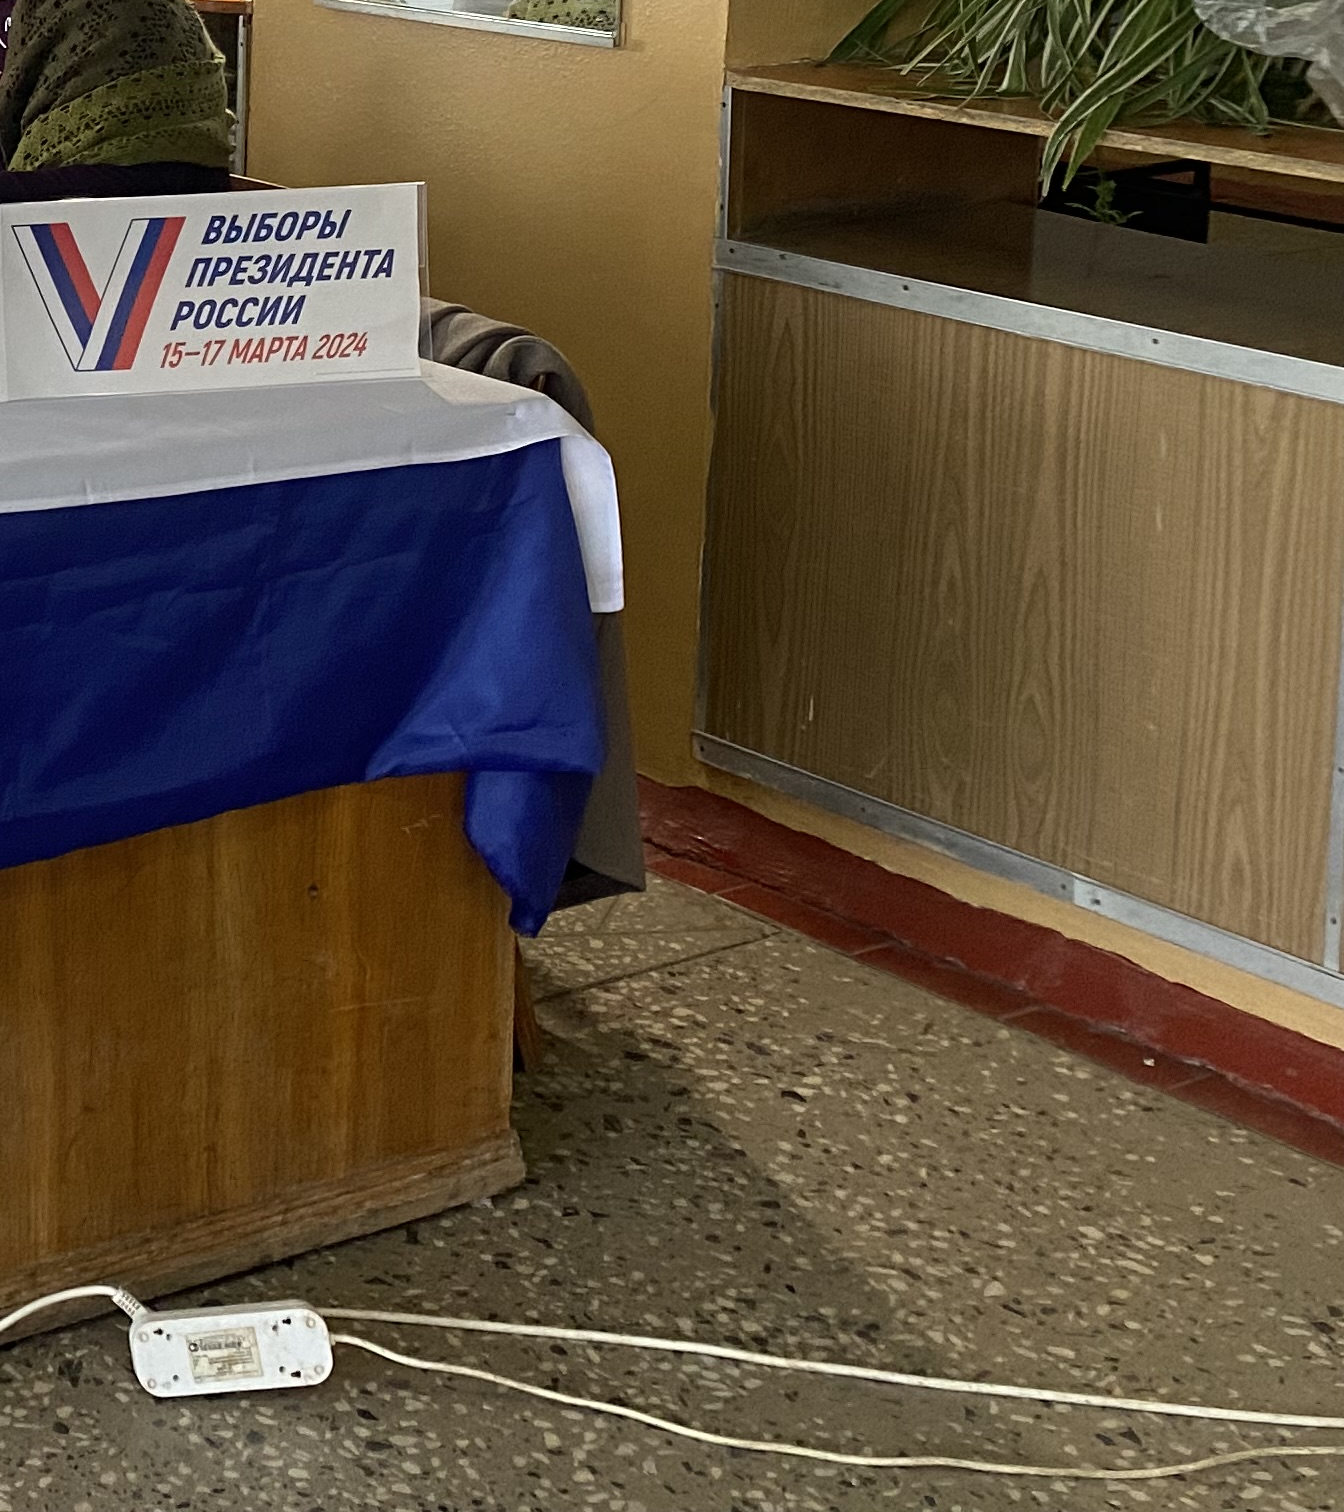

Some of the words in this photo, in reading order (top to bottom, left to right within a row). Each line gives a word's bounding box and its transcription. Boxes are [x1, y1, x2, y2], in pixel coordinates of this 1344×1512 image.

[201, 209, 352, 245] ВЫБОРЫ
[184, 249, 395, 288] ПРЕЗИДЕНТА
[170, 294, 306, 331] РОССИИ
[227, 335, 309, 364] МАРТА
[312, 332, 368, 360] 2024
